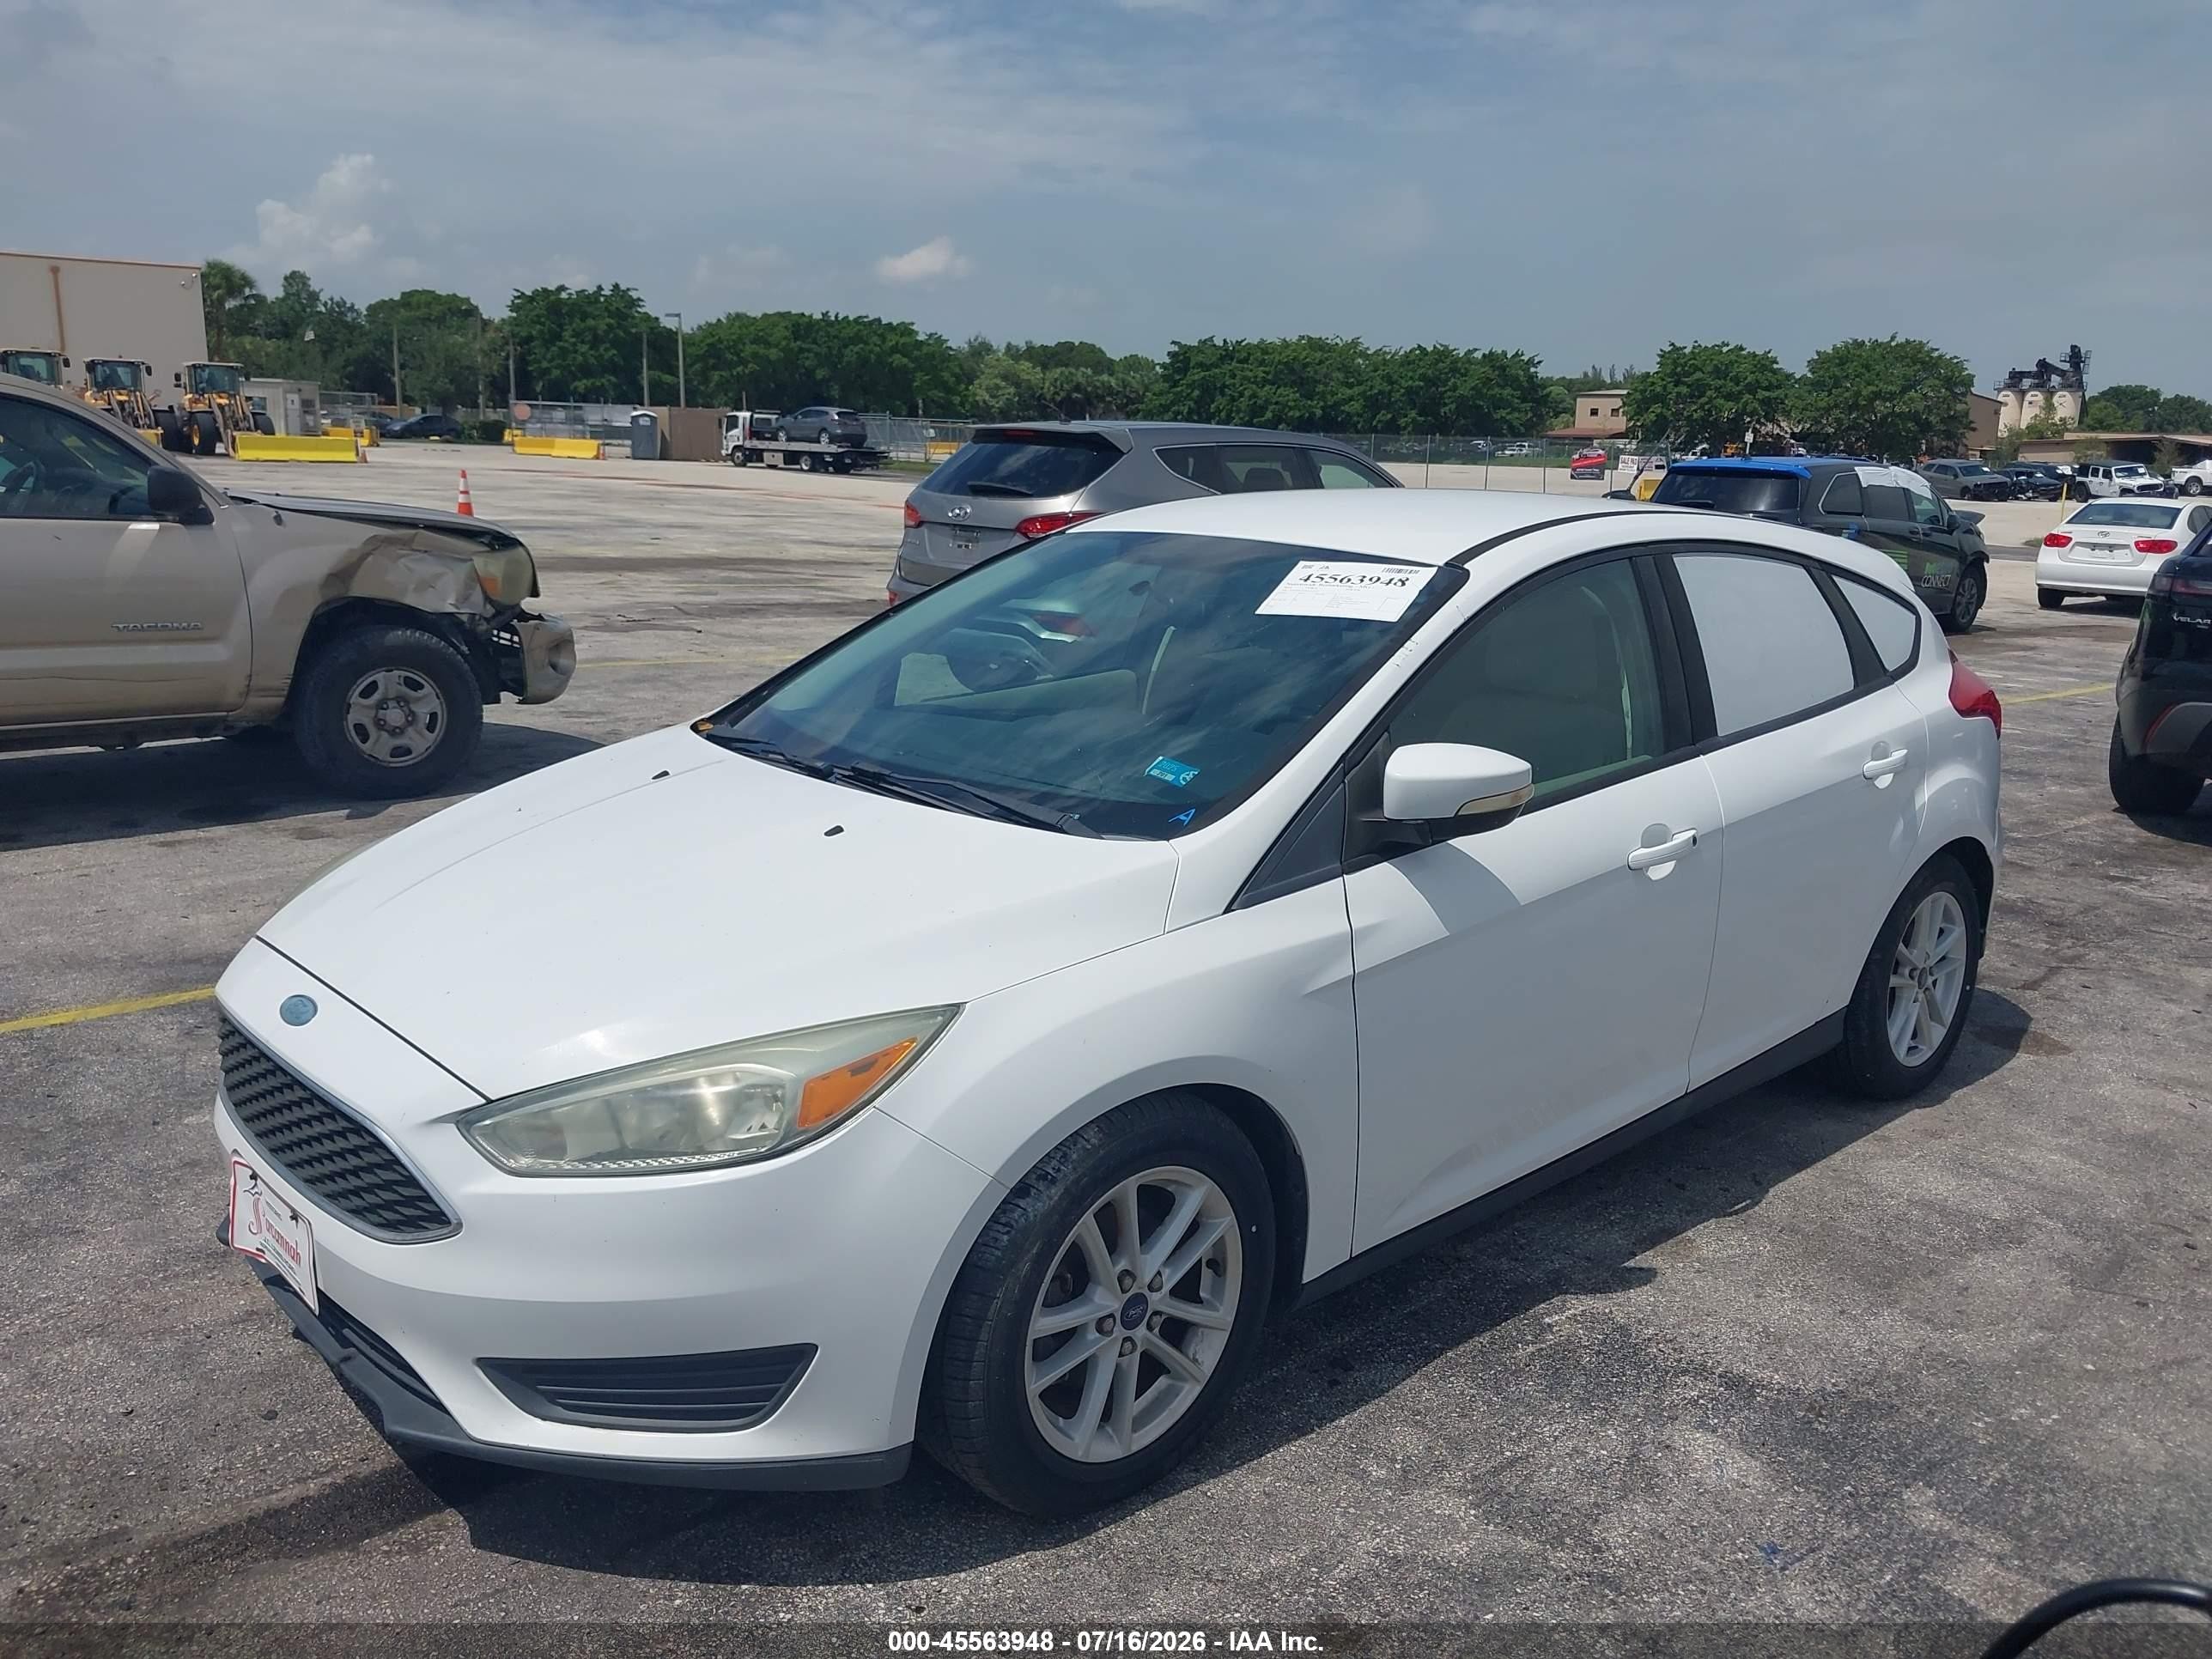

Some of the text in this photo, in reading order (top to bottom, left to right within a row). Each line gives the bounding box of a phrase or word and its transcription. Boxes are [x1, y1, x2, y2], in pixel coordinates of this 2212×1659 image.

[1298, 573, 1410, 587] 45563948
[1921, 574, 1951, 587] CONNECT
[2172, 612, 2211, 624] VELAR
[111, 623, 204, 632] TACOMA
